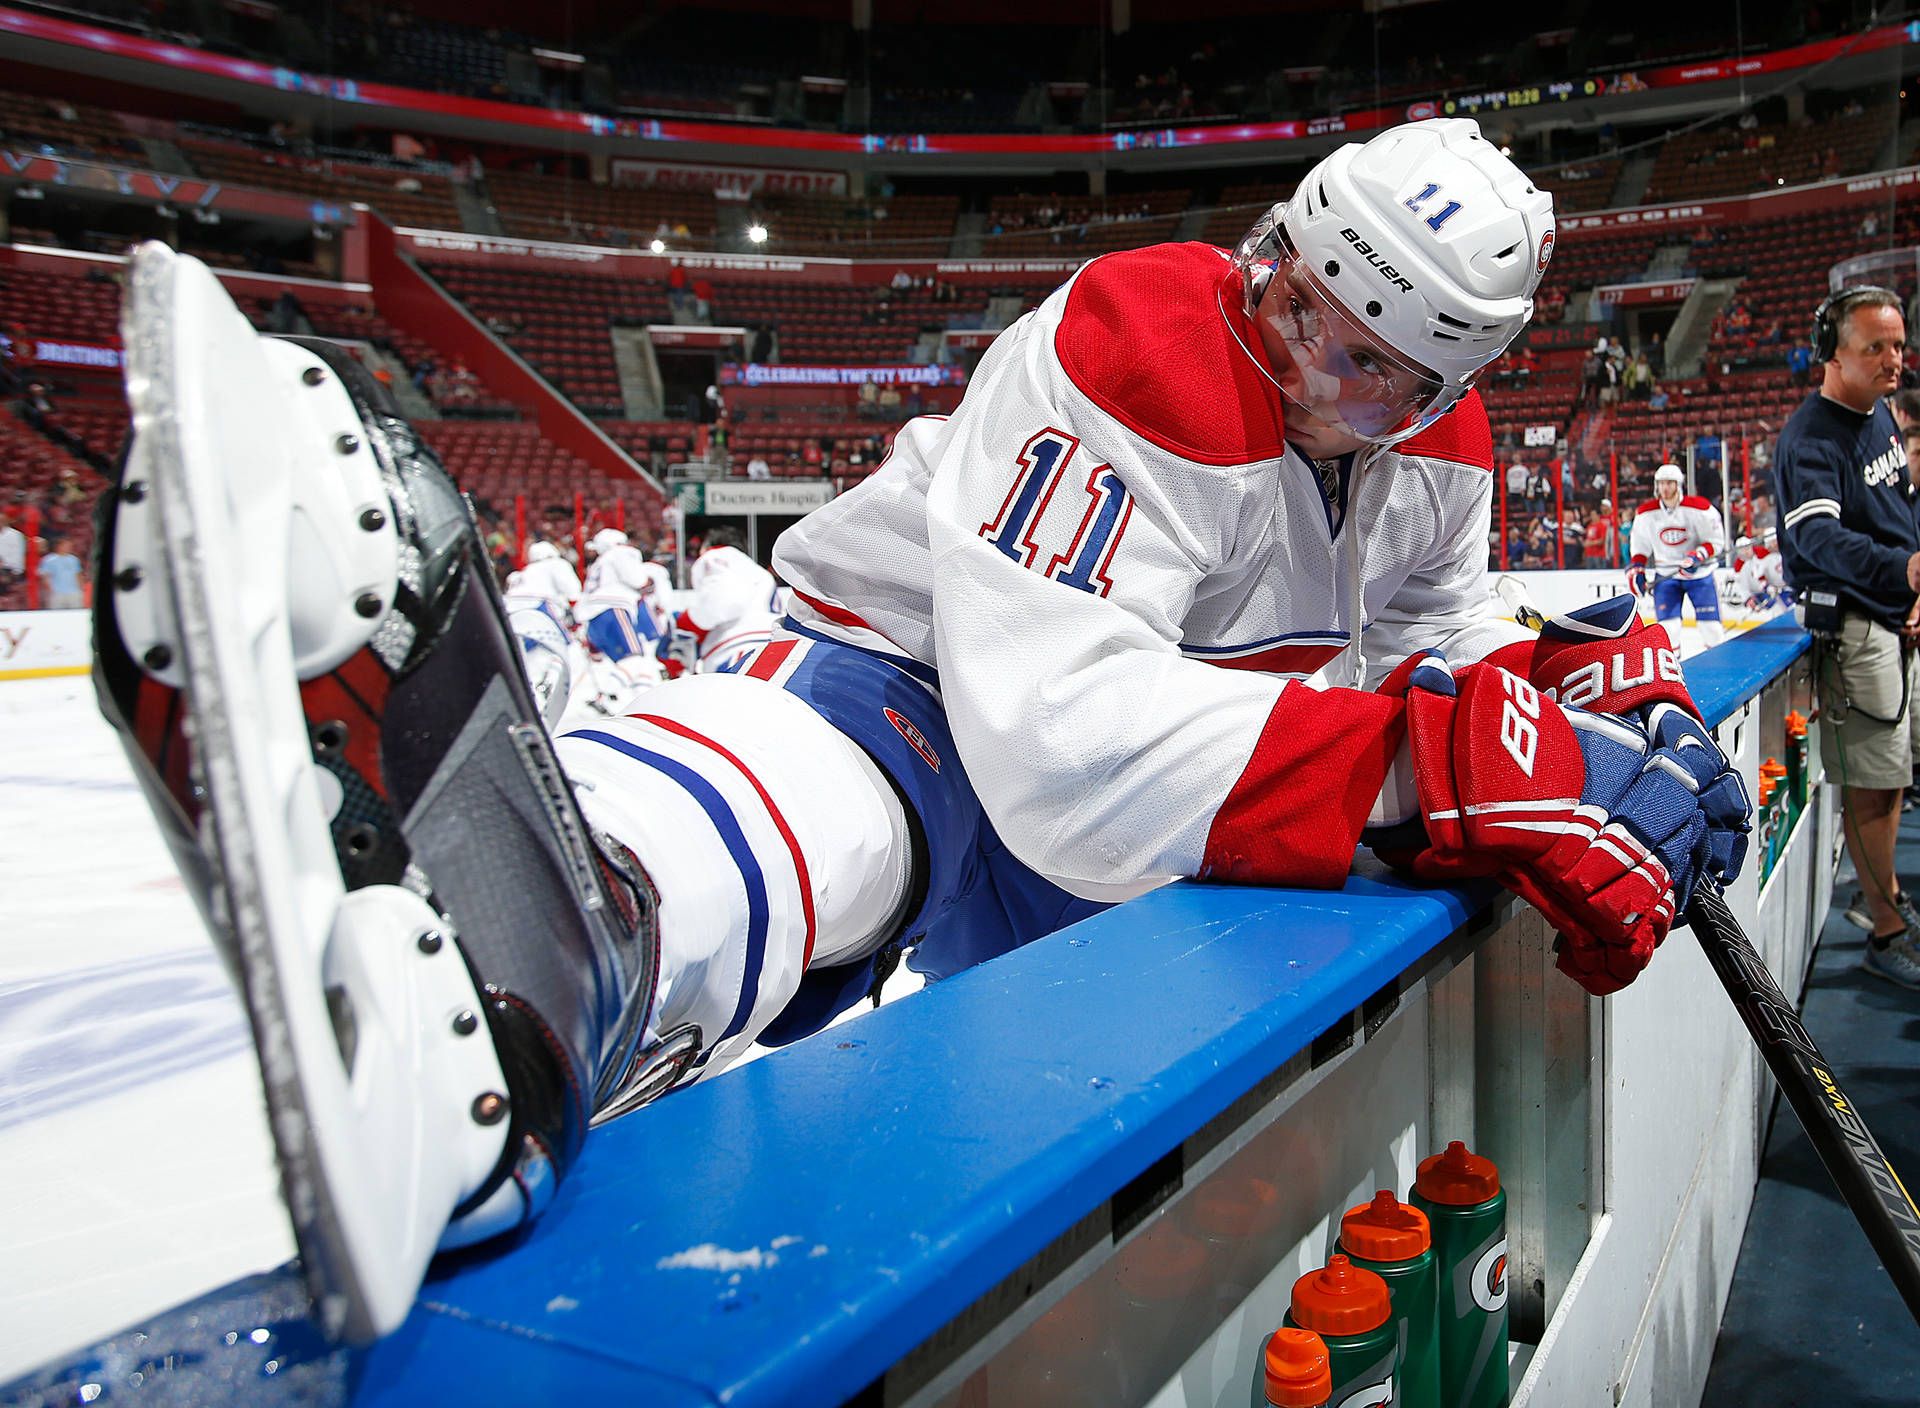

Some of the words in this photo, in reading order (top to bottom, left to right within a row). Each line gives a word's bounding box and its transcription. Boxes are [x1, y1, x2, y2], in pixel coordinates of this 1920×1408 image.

[1403, 182, 1464, 234] 11
[1339, 227, 1415, 295] BAUER
[978, 426, 1135, 599] 11
[1543, 647, 1688, 708] AUE
[1812, 1065, 1852, 1115] NXG
